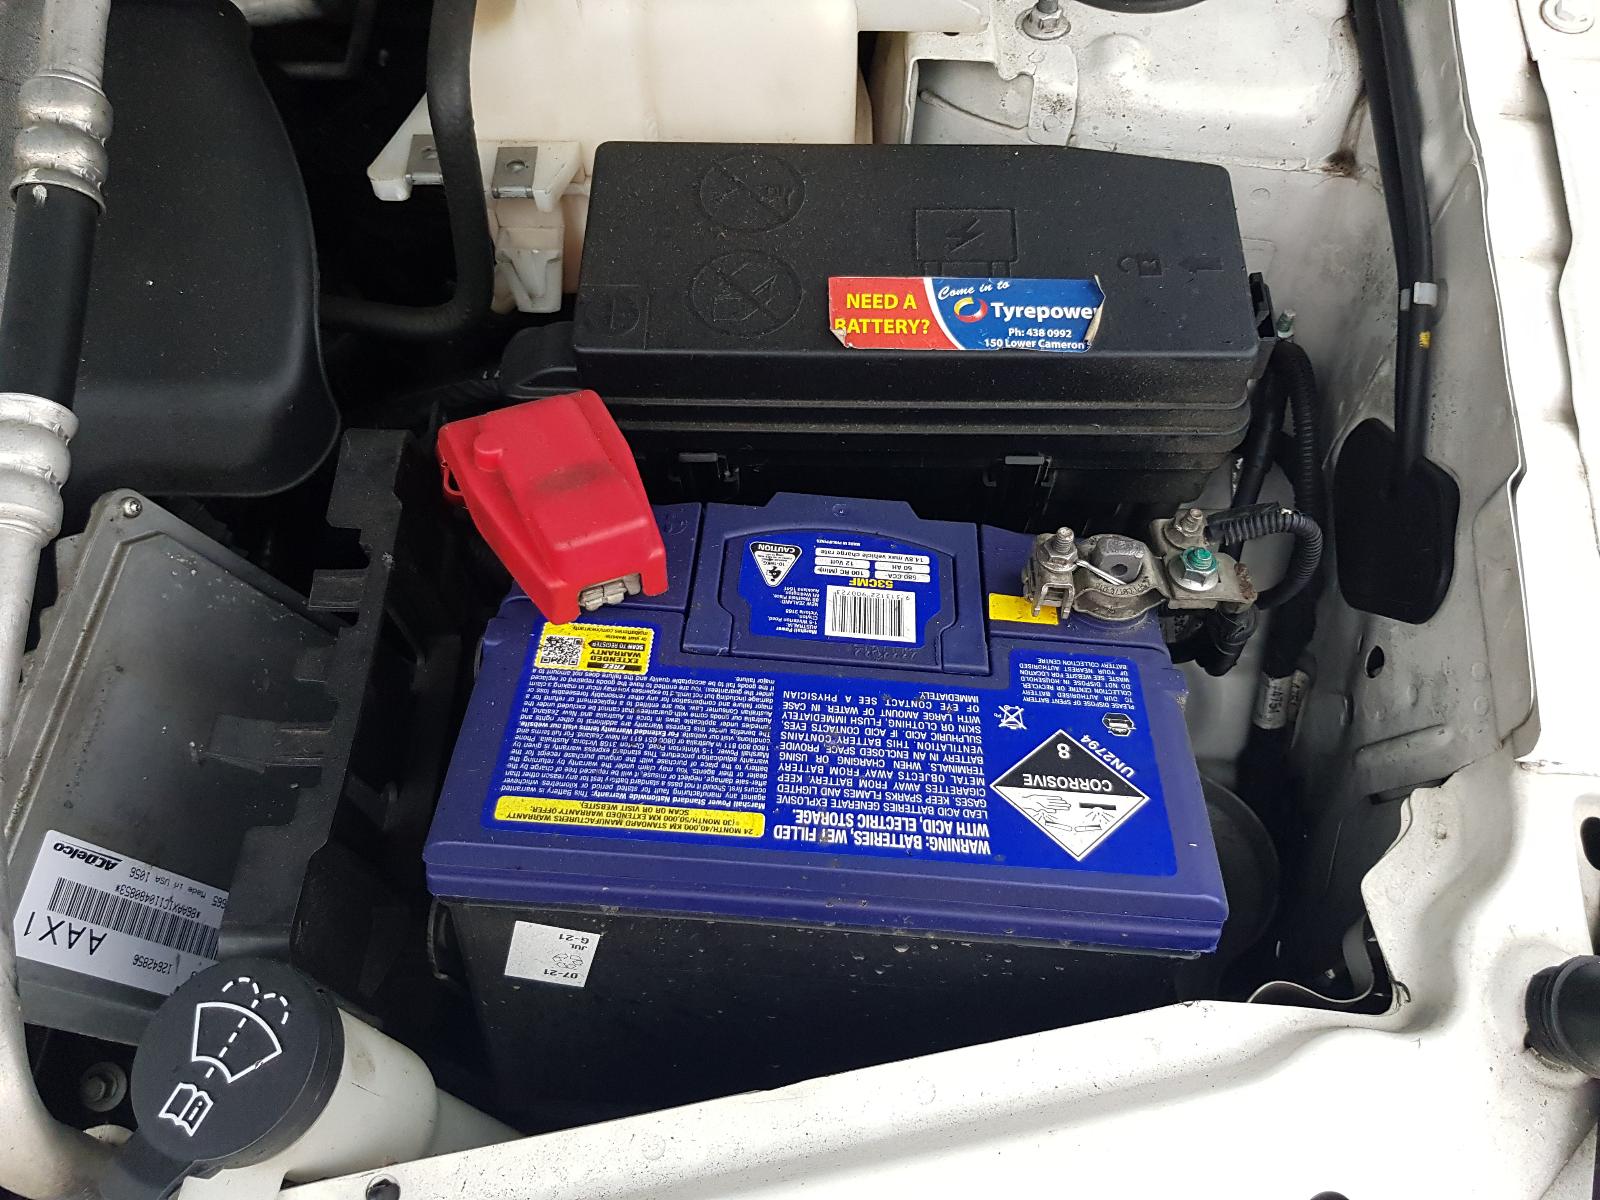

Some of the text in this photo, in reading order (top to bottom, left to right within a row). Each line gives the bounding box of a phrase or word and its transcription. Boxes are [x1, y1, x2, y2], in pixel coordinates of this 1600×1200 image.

[937, 280, 1010, 301] Come in to
[846, 293, 917, 309] NEED A
[834, 318, 930, 335] BATTERY?
[1008, 328, 1072, 338] Ph: 438 0992
[984, 338, 1085, 350] 150 Lower Cameron
[758, 543, 795, 554] CAUTION
[836, 550, 860, 558] charge
[848, 577, 893, 588] 53CMF
[589, 649, 641, 657] WARRANTY
[590, 655, 639, 664] EXTENDED
[783, 691, 979, 713] OF EYE CONTACT SEE A PHYSICIAN
[918, 691, 979, 703] IMMEDIATELY.
[782, 702, 980, 724] WITH LARGE AMOUNT OF WATER. IN CASE
[782, 712, 981, 733] SKIN OR CLOTHING, FLUSH IMMEDIATELY
[782, 721, 982, 743] SULPHURIC ACID. IF ACID CONTACTS EYES,
[780, 731, 983, 754] VENTILATION. THIS BATTERY CONTAINS
[780, 742, 984, 764] BATTERY IN AN ENCLOSED SPACE, PROVIDE
[1056, 743, 1070, 759] 8
[1080, 734, 1136, 778] UN2794
[779, 752, 984, 774] TERMINALS. WHEN CHARGING OR USING
[778, 763, 985, 785] METAL OBJECTS AWAY FROM BATTERY
[778, 773, 986, 796] CIGARETTES AWAY FROM BATTERY. KEEP
[1022, 773, 1113, 792] CORROSIVE
[628, 793, 670, 803] Nationwide
[672, 796, 705, 805] Standard
[707, 798, 731, 807] Power
[777, 784, 987, 807] GASES. KEEP SPARKS FLAMES AND LIGHTED
[733, 800, 765, 809] Marshall
[776, 795, 987, 818] LEAD ACID BATTERIES GENERATE EXPLOSIVE
[506, 813, 550, 821] WARRANTY
[558, 808, 603, 817] WARRANTY
[605, 811, 646, 820] EXTENDED
[553, 816, 622, 826] MANUFACTURERS
[625, 820, 666, 828] STANDARD
[792, 809, 990, 836] WITH ACID, ELECTRIC STORAGE.
[773, 825, 991, 854] WARNING: BATTERIES, WET FILLED
[53, 842, 119, 871] ACDelco
[129, 866, 150, 883] 1056
[155, 875, 170, 886] USA
[174, 882, 183, 890] in
[187, 886, 207, 901] Made
[558, 934, 589, 944] G-21
[132, 954, 173, 975] 12642856
[544, 968, 578, 979] 07-21
